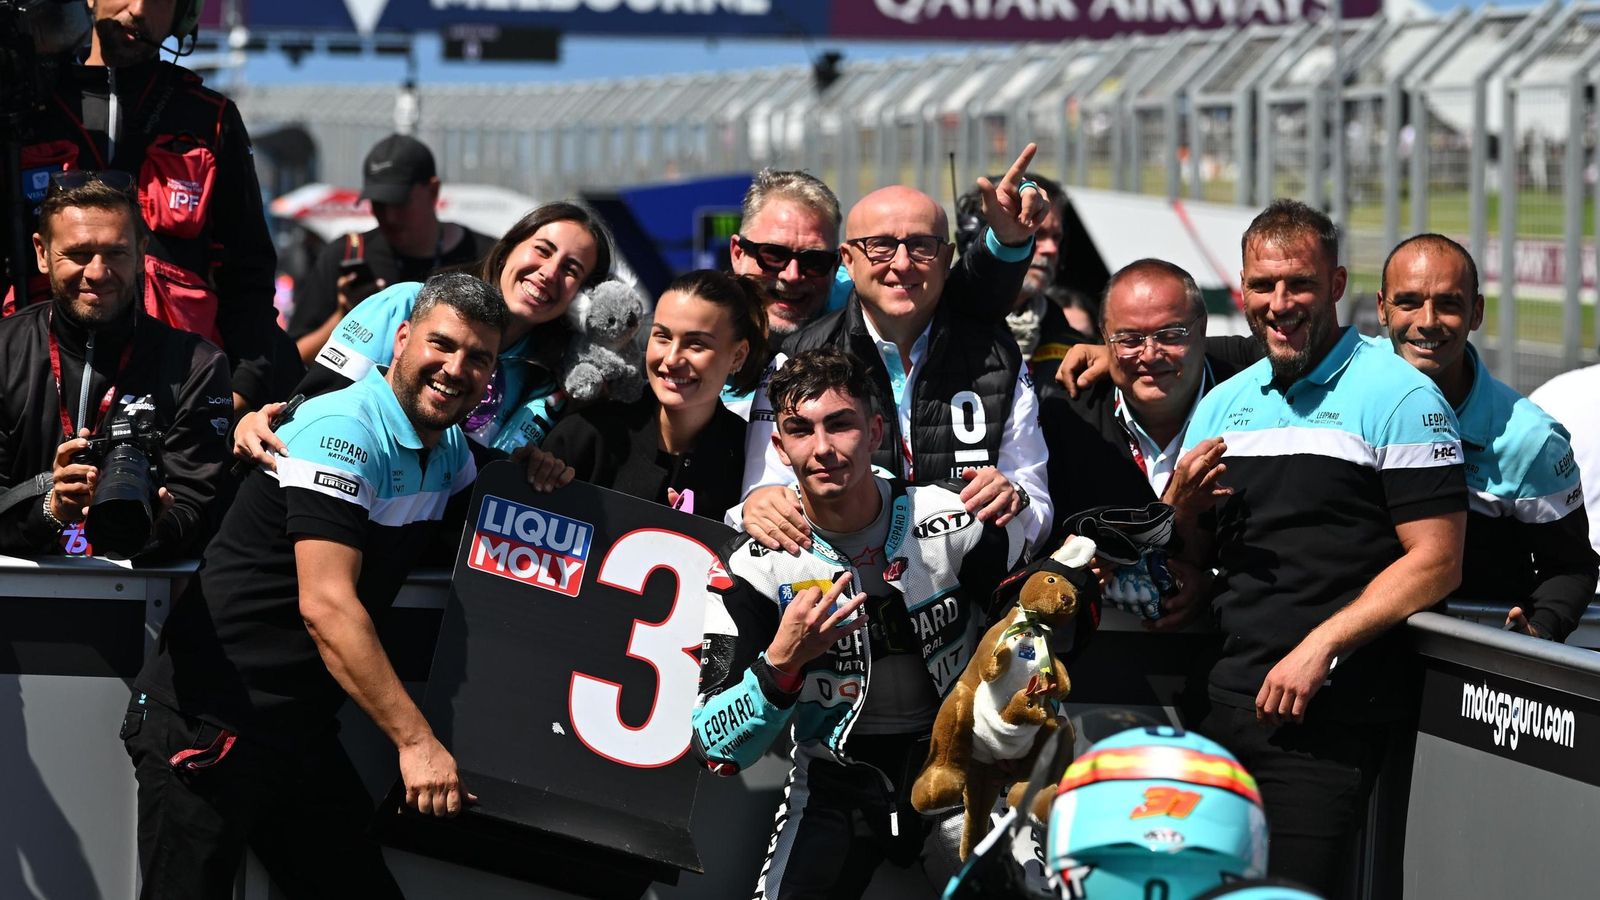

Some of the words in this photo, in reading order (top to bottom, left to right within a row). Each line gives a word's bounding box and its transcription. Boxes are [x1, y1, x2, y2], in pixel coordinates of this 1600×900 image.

[170, 191, 199, 212] IPF
[1316, 411, 1340, 421] LEOPARD
[112, 429, 132, 437] Nikon
[320, 436, 369, 464] LEOPARD
[327, 452, 356, 465] NATURAL
[1434, 446, 1456, 459] HRC
[318, 473, 357, 494] PIRELLI
[483, 500, 587, 556] LIQUI
[919, 510, 967, 538] KYT
[62, 529, 88, 555] 75
[474, 535, 583, 590] MOLY
[568, 527, 718, 769] 3
[696, 693, 755, 752] LEOPARD
[1461, 680, 1575, 750] motogpguru.com
[719, 729, 755, 758] NATURAL
[1130, 786, 1203, 819] 31
